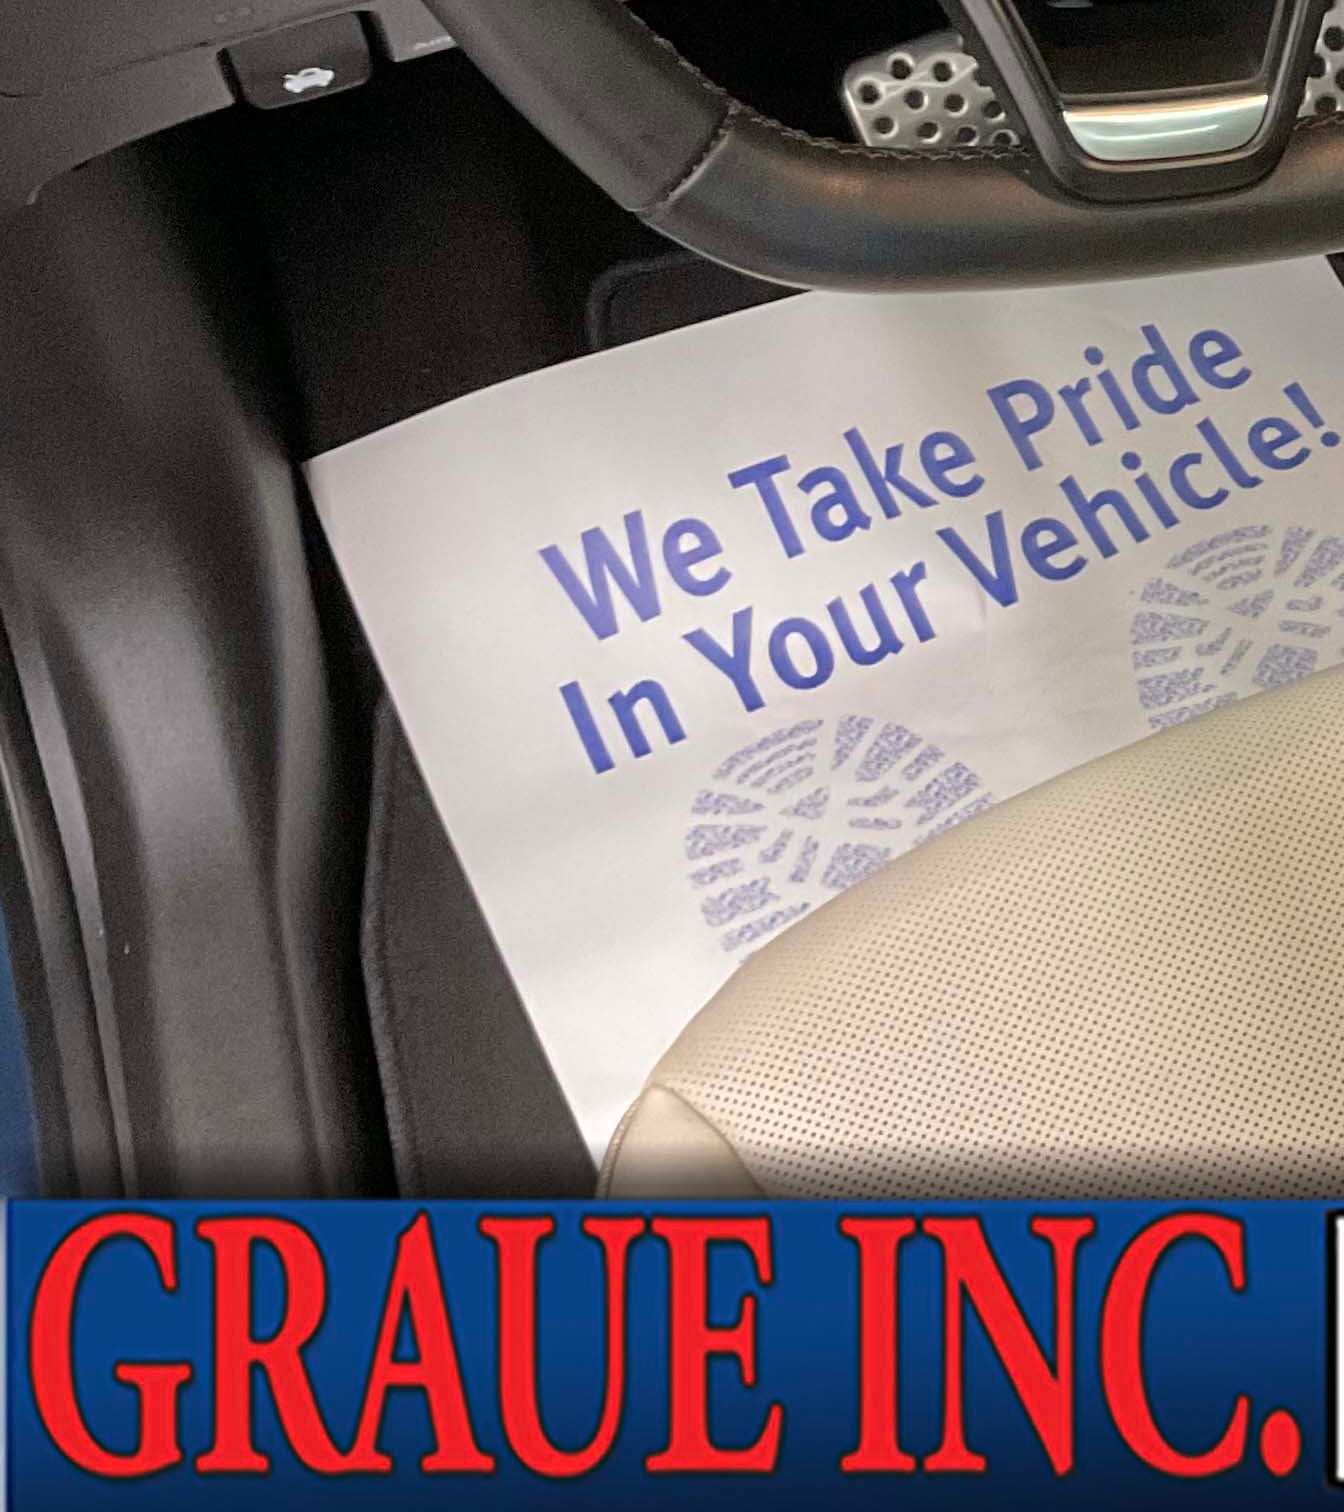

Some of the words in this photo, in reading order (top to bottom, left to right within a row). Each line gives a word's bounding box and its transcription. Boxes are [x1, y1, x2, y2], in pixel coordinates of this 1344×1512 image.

[538, 509, 733, 641] We
[727, 427, 986, 560] Take
[986, 323, 1254, 472] Pride
[559, 671, 686, 775] In
[682, 560, 938, 712] Your
[936, 381, 1343, 610] Vehicle!
